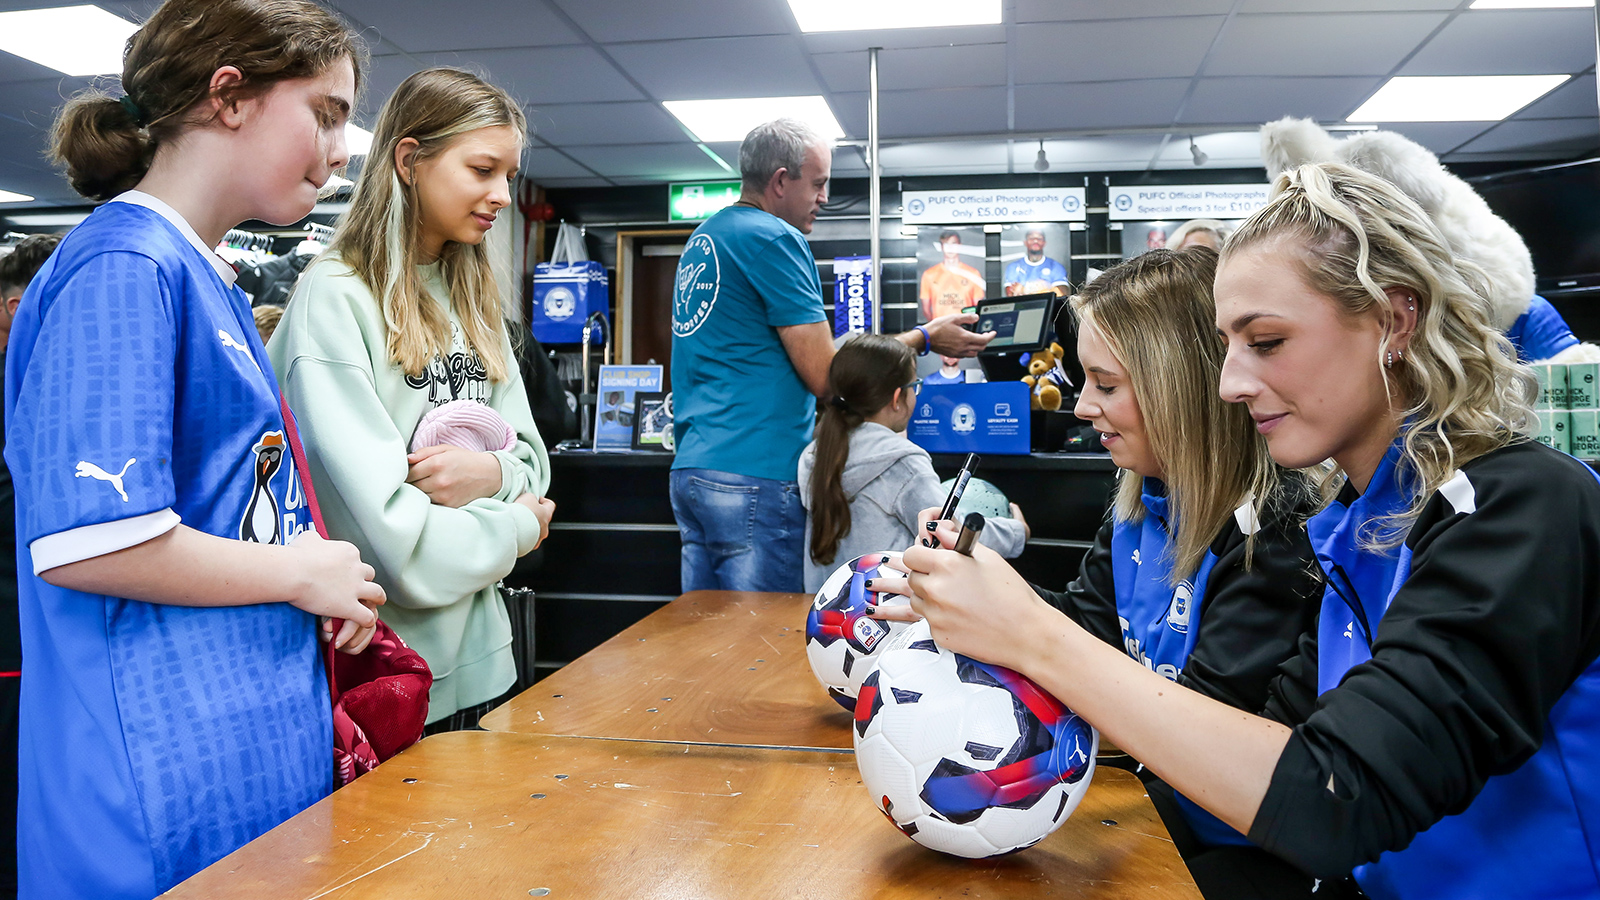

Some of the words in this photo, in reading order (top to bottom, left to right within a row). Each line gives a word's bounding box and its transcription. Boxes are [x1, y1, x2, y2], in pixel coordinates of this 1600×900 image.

[928, 196, 956, 205] PUFC
[958, 195, 994, 204] Official
[996, 194, 1059, 205] Photographs
[1138, 191, 1166, 200] PUFC
[1168, 191, 1202, 200] Official
[1205, 191, 1266, 200] Photographs
[952, 209, 974, 218] Only
[977, 207, 1009, 217] £5.00
[1012, 208, 1035, 216] each
[1137, 205, 1173, 214] Special
[1175, 204, 1203, 213] offers
[1205, 204, 1211, 213] 3
[1213, 204, 1227, 212] for
[696, 282, 714, 290] 2017
[672, 300, 709, 332] THORPES
[603, 371, 626, 379] CLUB
[628, 371, 651, 379] SHOP
[602, 378, 637, 387] SIGNING
[639, 378, 658, 387] DAY
